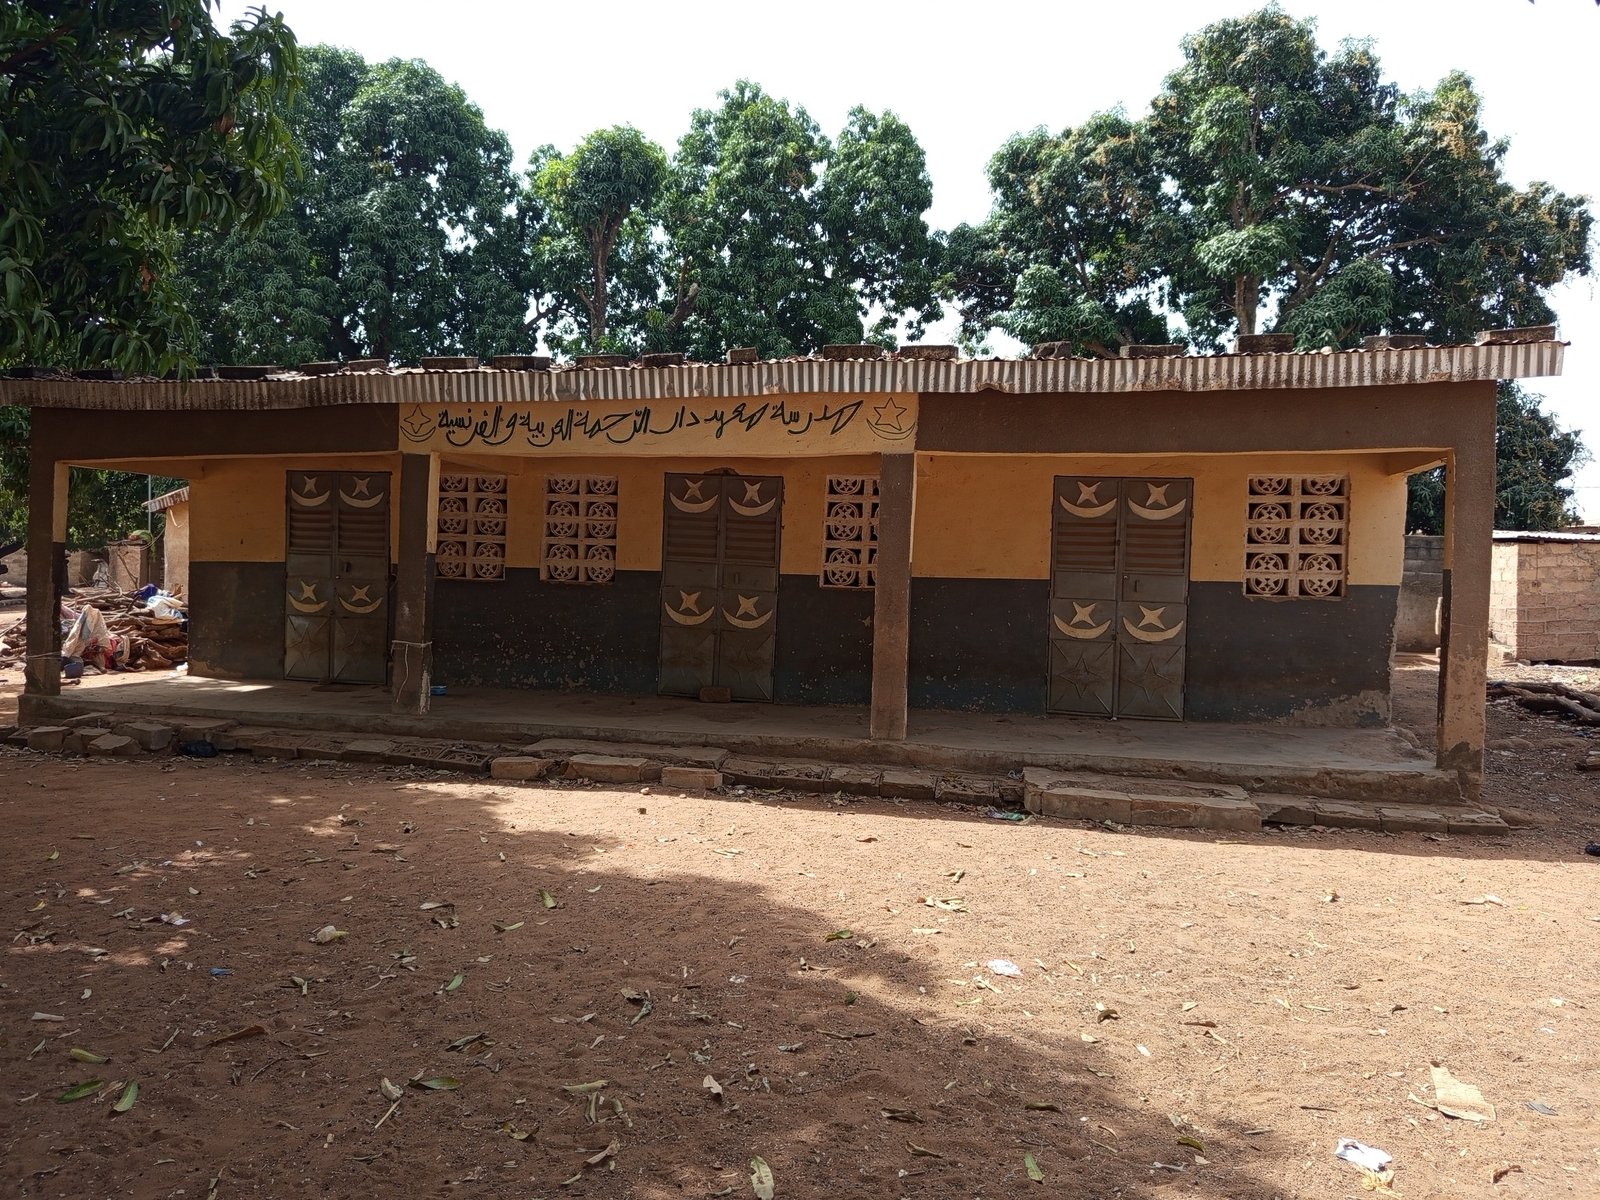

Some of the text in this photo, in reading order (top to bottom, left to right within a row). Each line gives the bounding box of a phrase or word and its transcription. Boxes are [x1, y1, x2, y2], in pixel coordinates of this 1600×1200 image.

[519, 408, 575, 447] العربية
[649, 405, 700, 434] دار
[770, 399, 864, 435] مدرسة
